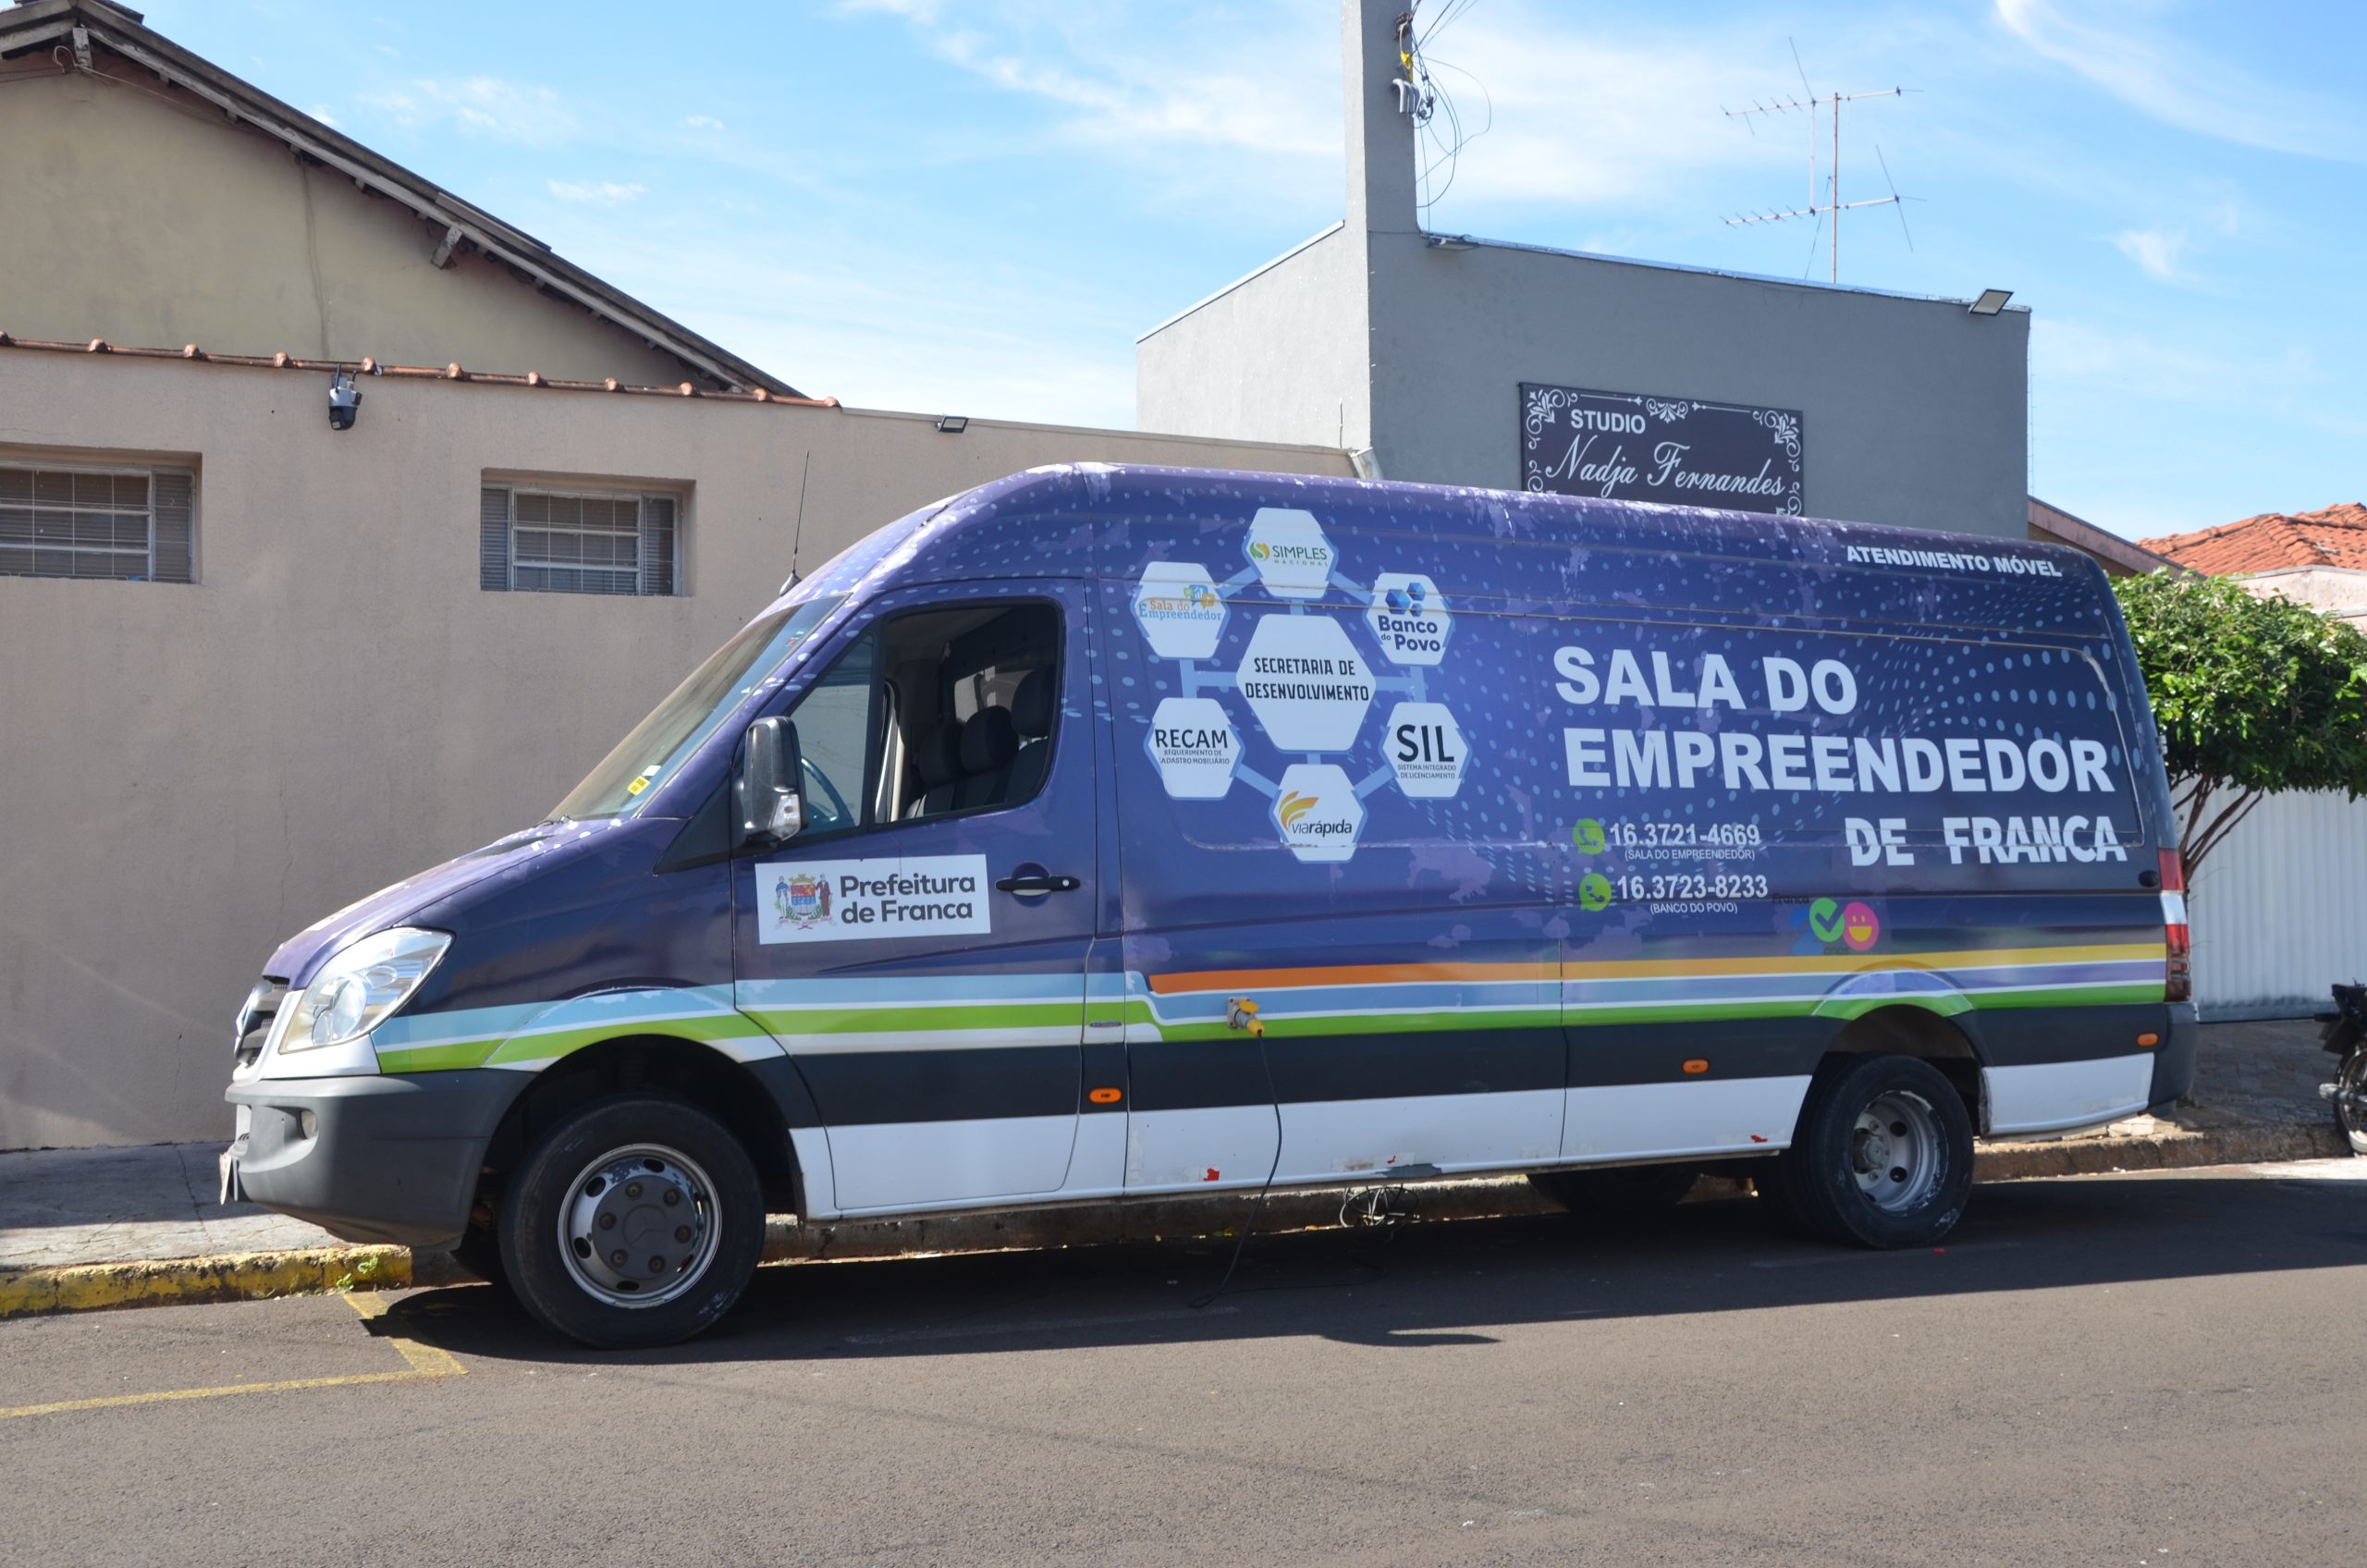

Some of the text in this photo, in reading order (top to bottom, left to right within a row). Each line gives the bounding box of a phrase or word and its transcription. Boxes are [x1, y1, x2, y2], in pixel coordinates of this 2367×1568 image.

[1571, 410, 1646, 434] STUDIO
[1545, 434, 1784, 498] Nadja Fernandes
[1272, 545, 1327, 560] SIMPLES
[1847, 545, 2063, 577] ATENDIMENTO MÓVEL
[1138, 603, 1221, 620] Empreendedor
[1149, 599, 1190, 611] Sala do
[1378, 615, 1438, 634] Banco
[1380, 632, 1441, 652] do Povo
[1254, 657, 1355, 676] SECRETARIA DE
[1245, 682, 1368, 701] DESENVOLVIMENTO
[1553, 646, 1858, 715] SALA DO
[1155, 729, 1228, 749] RECAM
[1396, 724, 1454, 763] SIL
[1164, 748, 1213, 756] REQUERIMENTO
[1564, 728, 2116, 792] EMPREENDEDOR
[1610, 823, 1760, 847] 16.3721-4669
[1845, 815, 2127, 866] DE FRANCA
[1625, 849, 1755, 862] (SALA DO EMPREENDEDOR)
[840, 873, 975, 898] Prefeitura
[1617, 875, 1768, 899] 16.3723-8233
[840, 901, 875, 924] de
[881, 900, 973, 922] Franca
[1650, 902, 1737, 914] (BANCO DO POVO)
